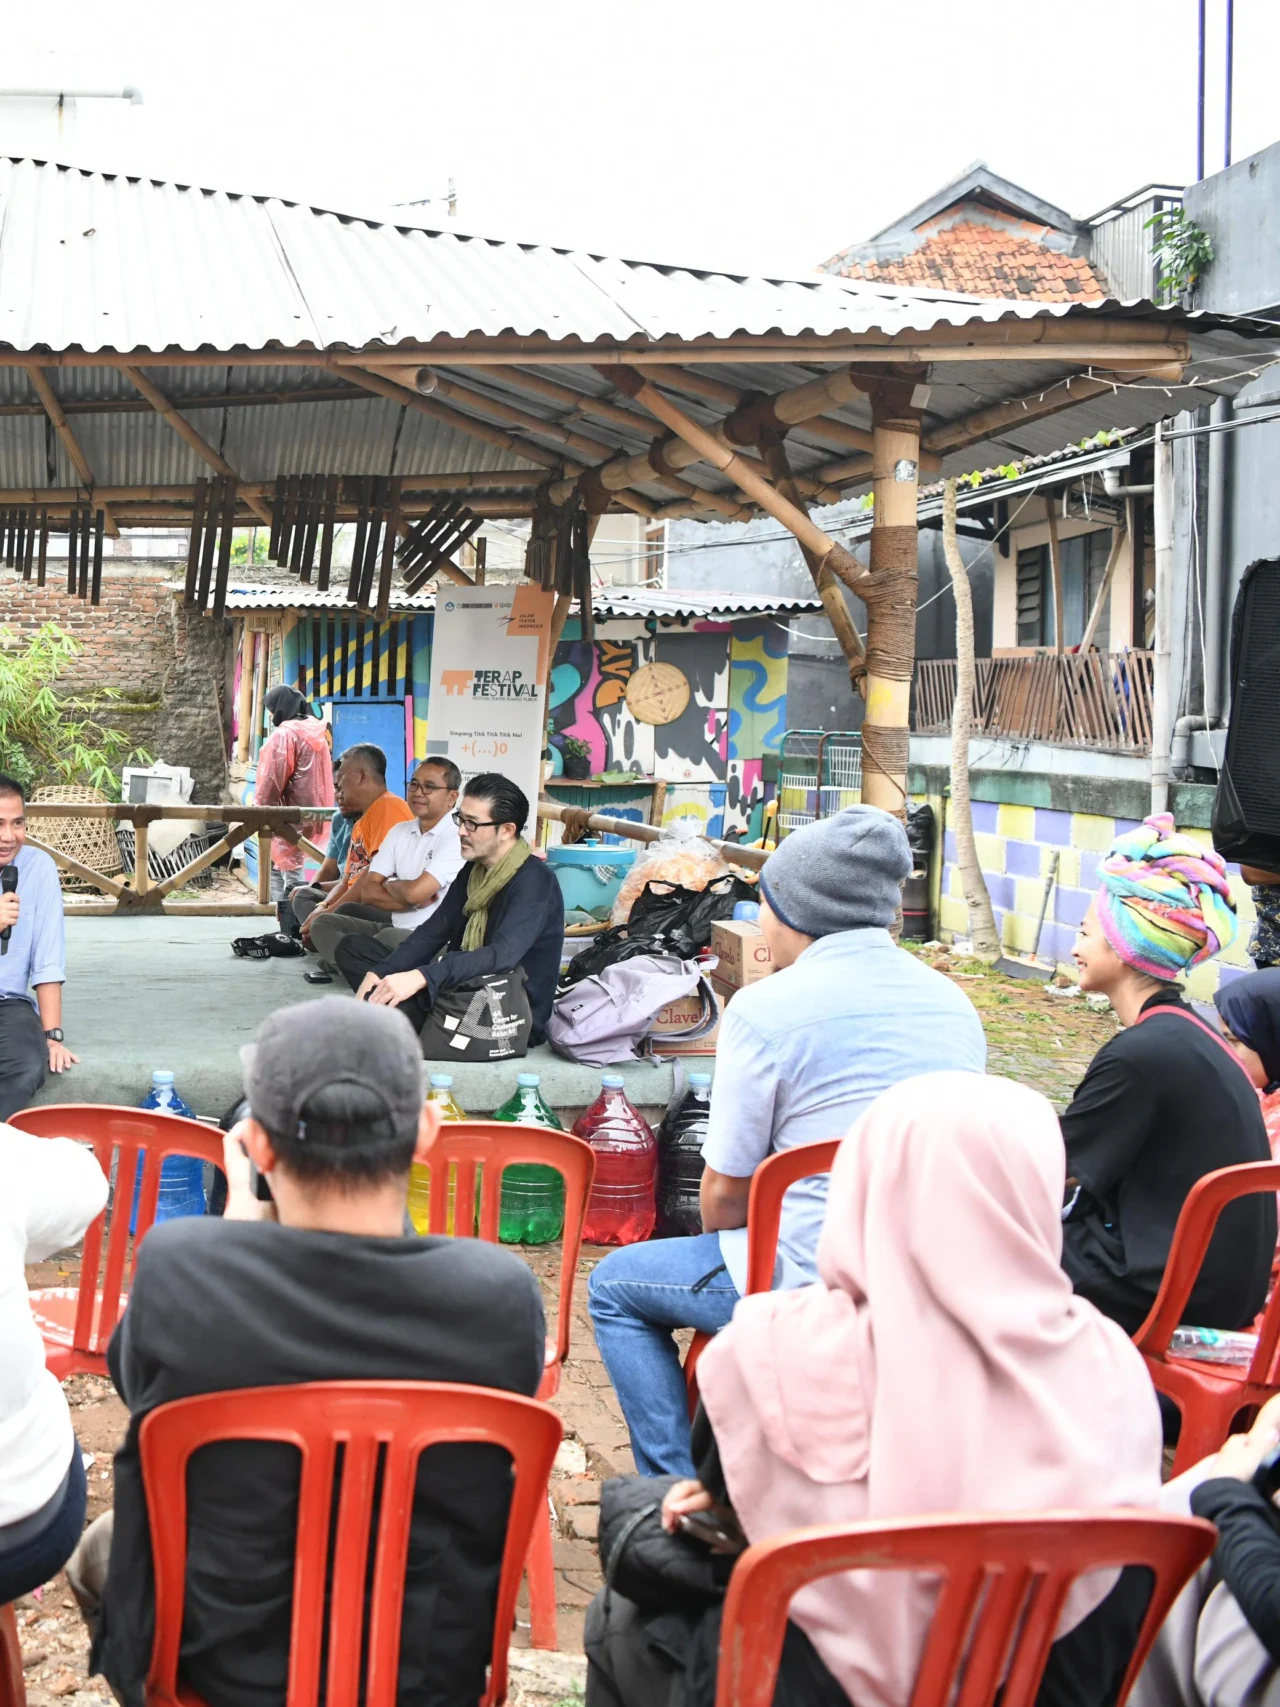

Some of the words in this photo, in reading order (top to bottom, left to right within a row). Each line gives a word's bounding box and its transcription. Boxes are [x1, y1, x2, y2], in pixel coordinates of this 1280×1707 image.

[473, 670, 522, 684] TERAP
[472, 683, 538, 697] FESTIVAL
[449, 730, 473, 738] Simpang
[656, 1007, 711, 1025] Clavel
